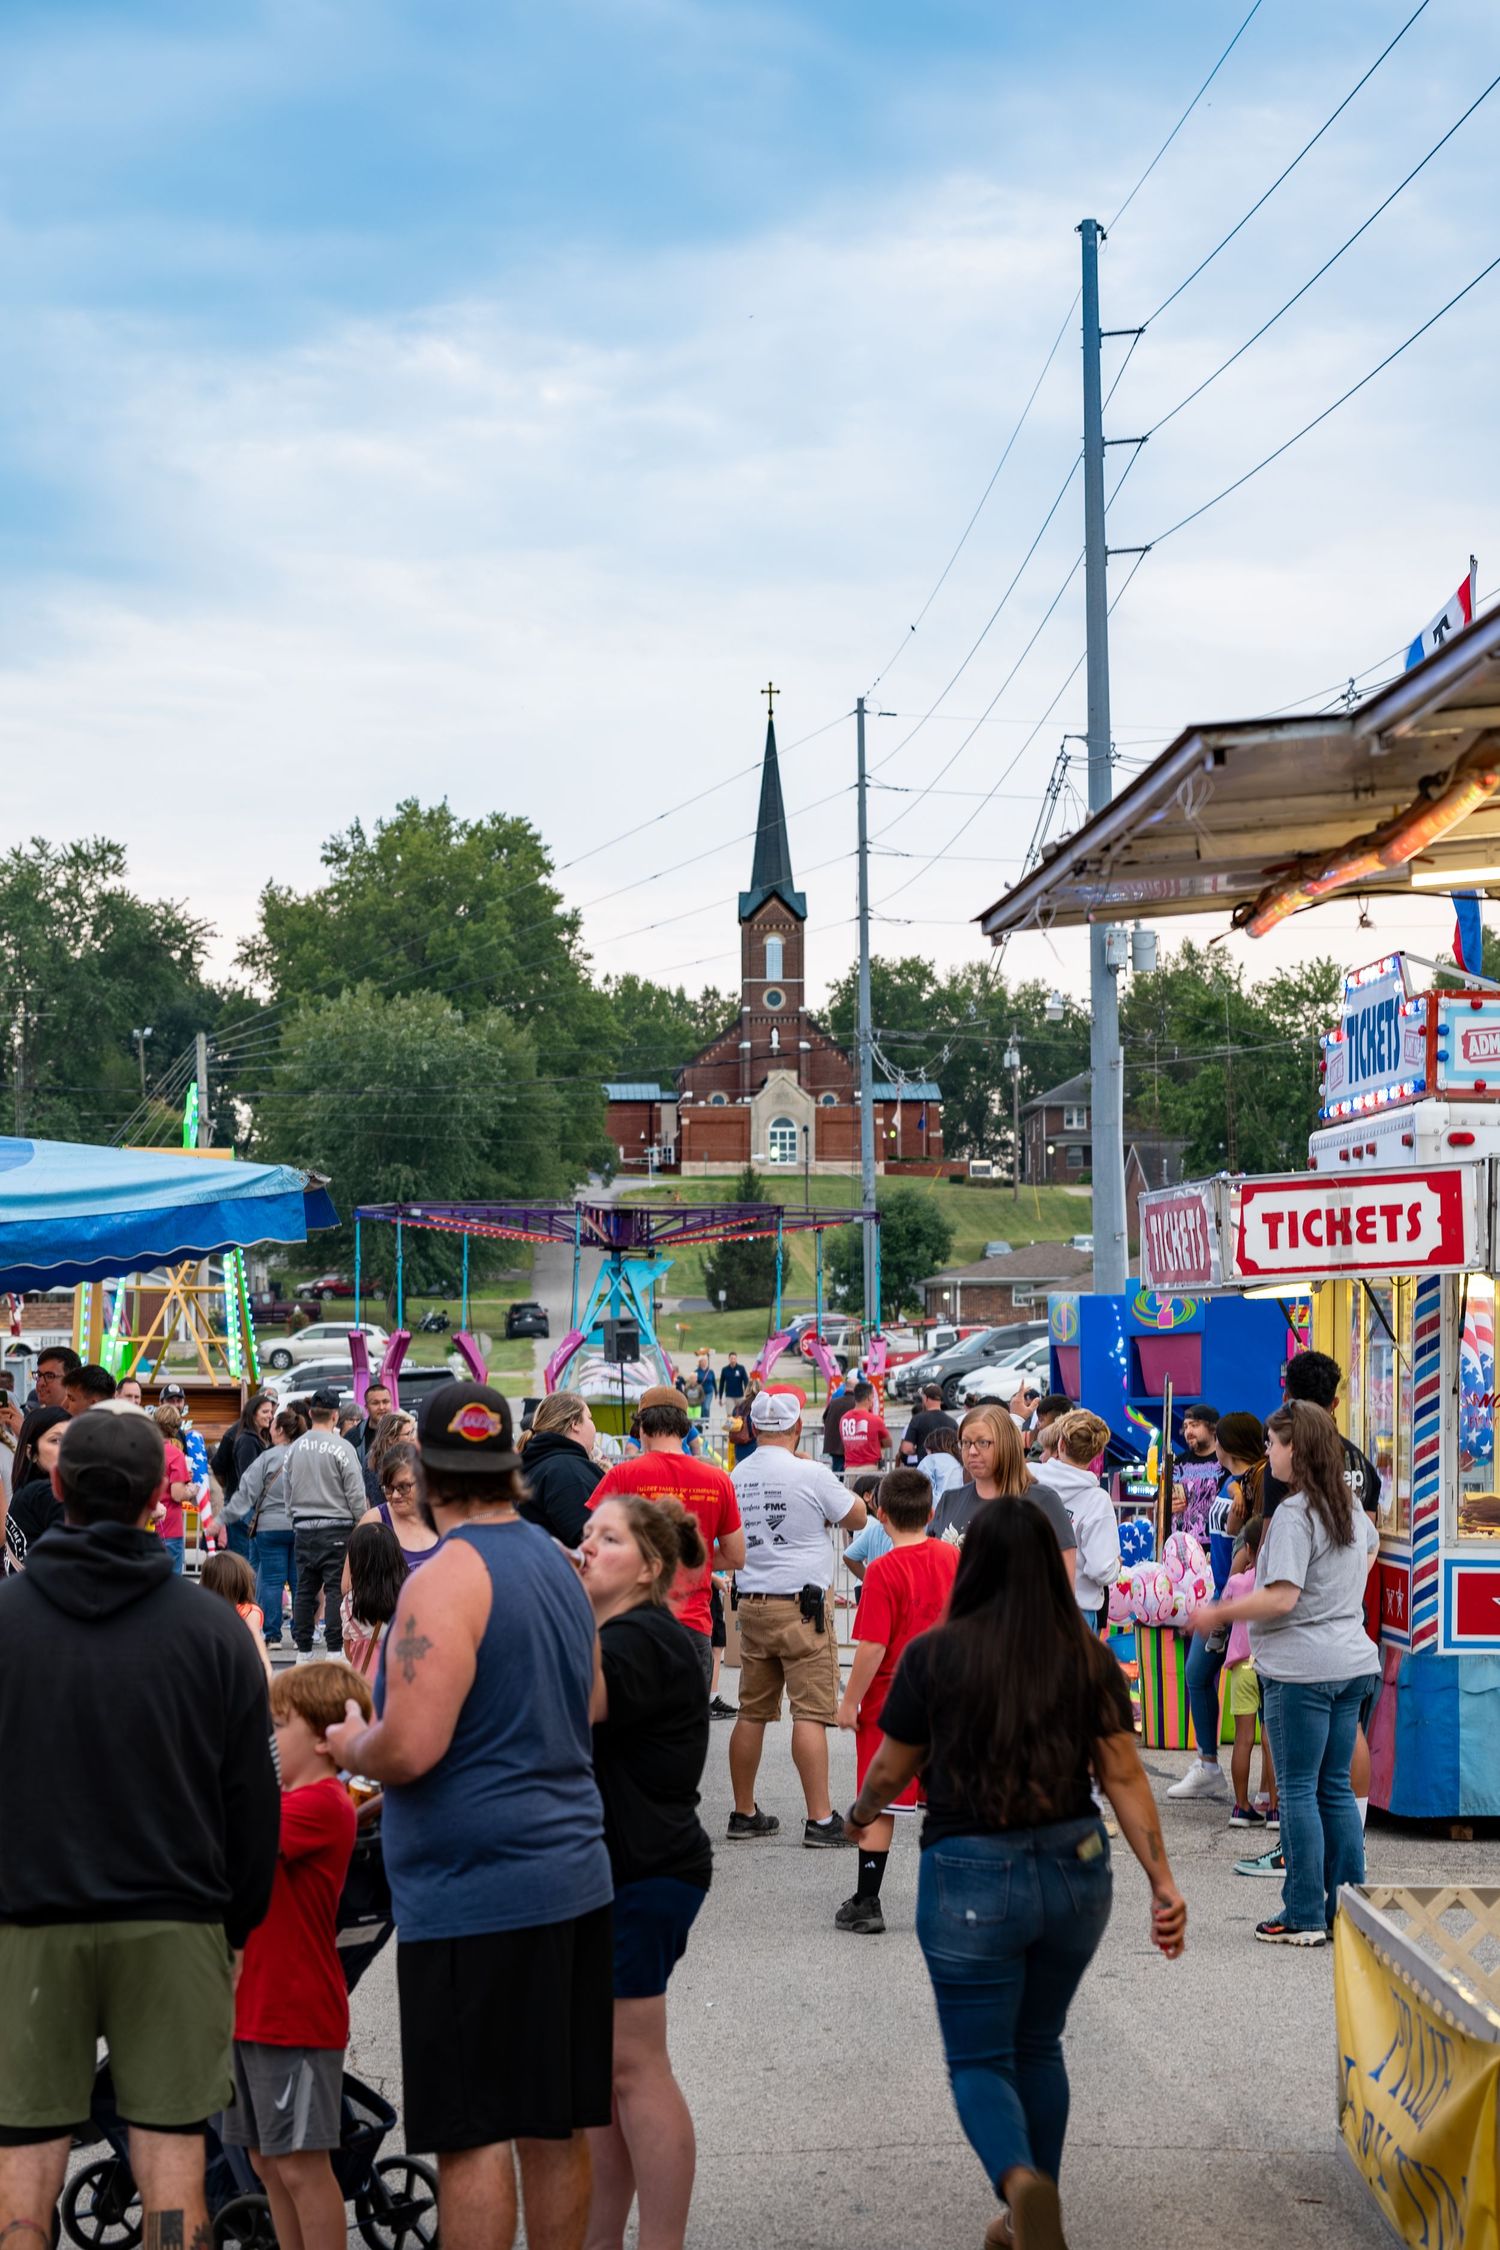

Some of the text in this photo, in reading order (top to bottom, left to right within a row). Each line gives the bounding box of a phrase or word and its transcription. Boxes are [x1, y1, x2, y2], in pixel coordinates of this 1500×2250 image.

[1347, 995, 1400, 1084] TICKETS
[1469, 1033, 1500, 1056] ADM
[1262, 1202, 1421, 1250] TICKETS
[1150, 1206, 1208, 1273] TICKETS
[842, 1418, 857, 1436] RG
[299, 1438, 349, 1467] Angeles
[1343, 1470, 1364, 1491] ep
[763, 1503, 787, 1511] FMC
[9, 1524, 22, 1544] TIME
